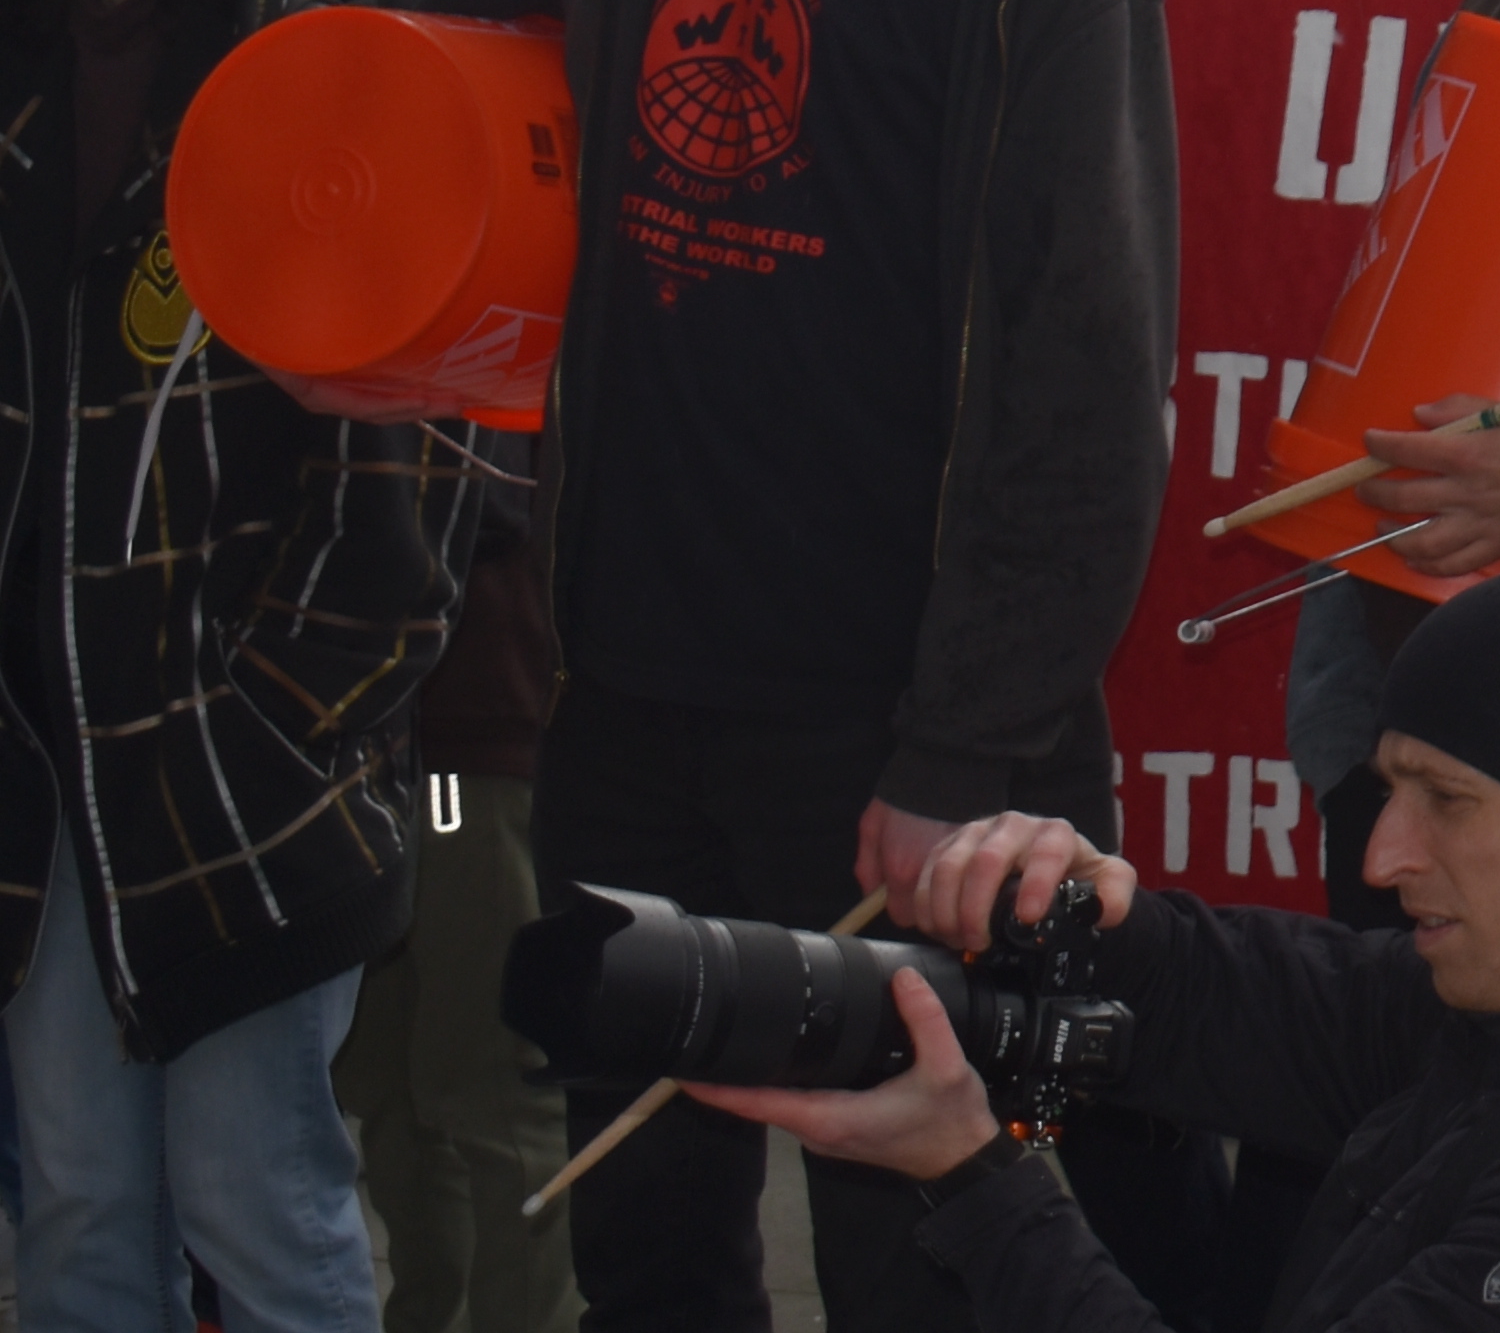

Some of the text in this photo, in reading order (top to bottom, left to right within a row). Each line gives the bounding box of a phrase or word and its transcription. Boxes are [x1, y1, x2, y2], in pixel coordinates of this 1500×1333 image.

[685, 240, 777, 276] WORLD
[706, 218, 827, 258] WORKERS
[1053, 1018, 1071, 1064] Nikon
